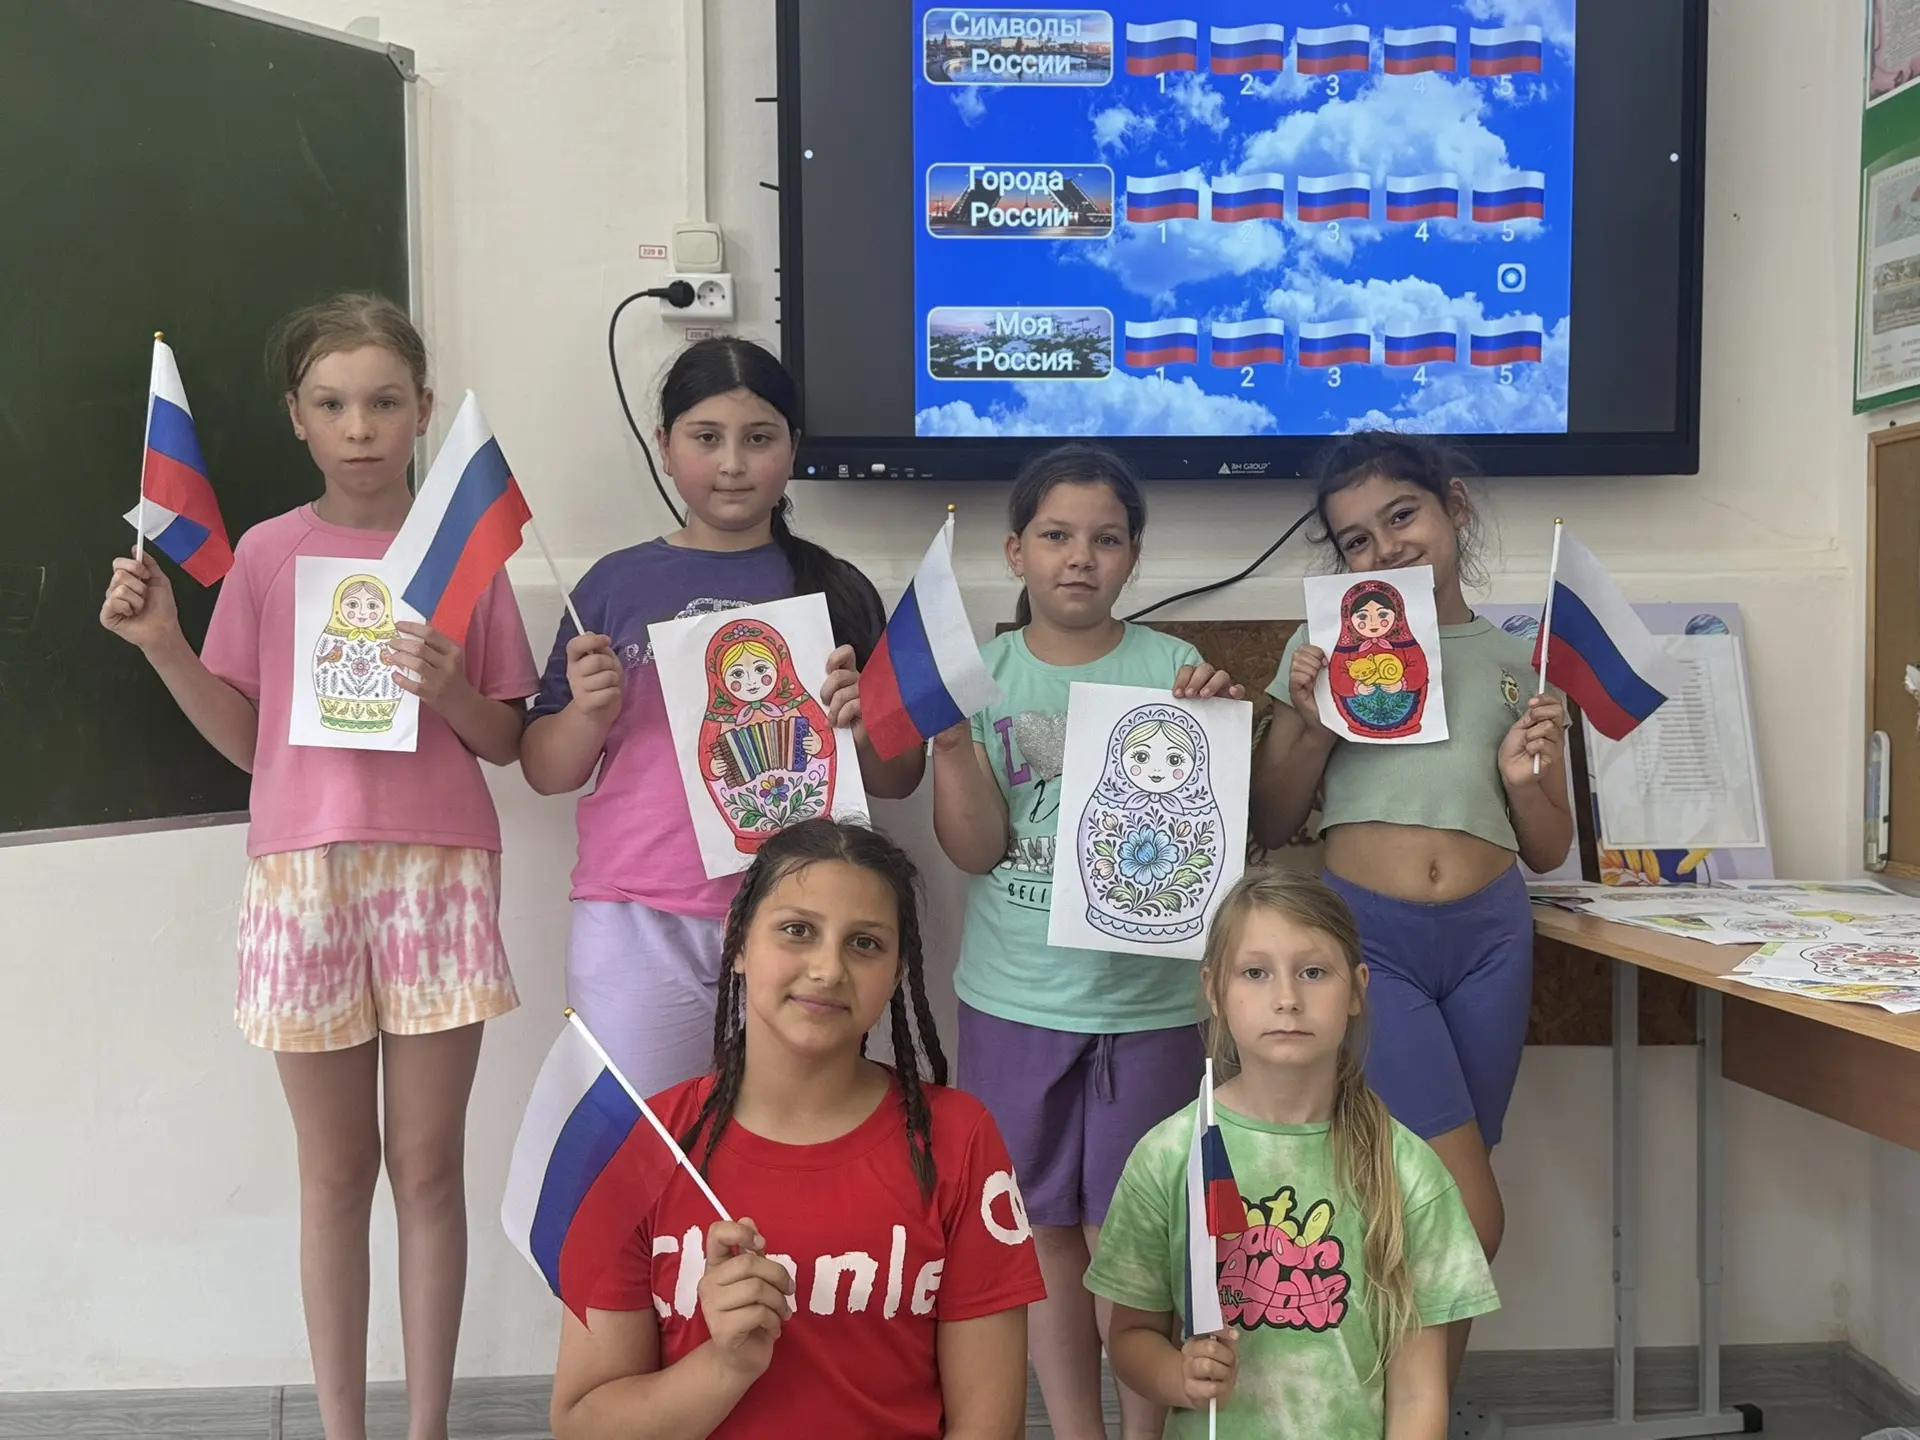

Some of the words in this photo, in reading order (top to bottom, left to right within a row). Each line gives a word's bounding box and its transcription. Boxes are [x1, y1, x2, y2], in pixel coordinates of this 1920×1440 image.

[950, 12, 1082, 37] Символы
[971, 48, 1071, 74] России
[1155, 73, 1166, 94] 1
[1240, 73, 1255, 95] 2
[1325, 75, 1340, 96] 3
[1413, 74, 1427, 95] 4
[1500, 75, 1513, 96] 5
[968, 166, 1065, 195] Города
[970, 202, 1070, 228] России
[1157, 223, 1167, 243] 1
[1327, 223, 1340, 243] 3
[1414, 222, 1430, 243] 4
[1501, 222, 1515, 242] 5
[995, 312, 1053, 336] Моя
[976, 347, 1075, 372] Россия
[1155, 367, 1165, 386] 1
[1240, 367, 1255, 387] 2
[1327, 367, 1342, 387] 3
[1412, 366, 1428, 386] 4
[1500, 365, 1513, 385] 5
